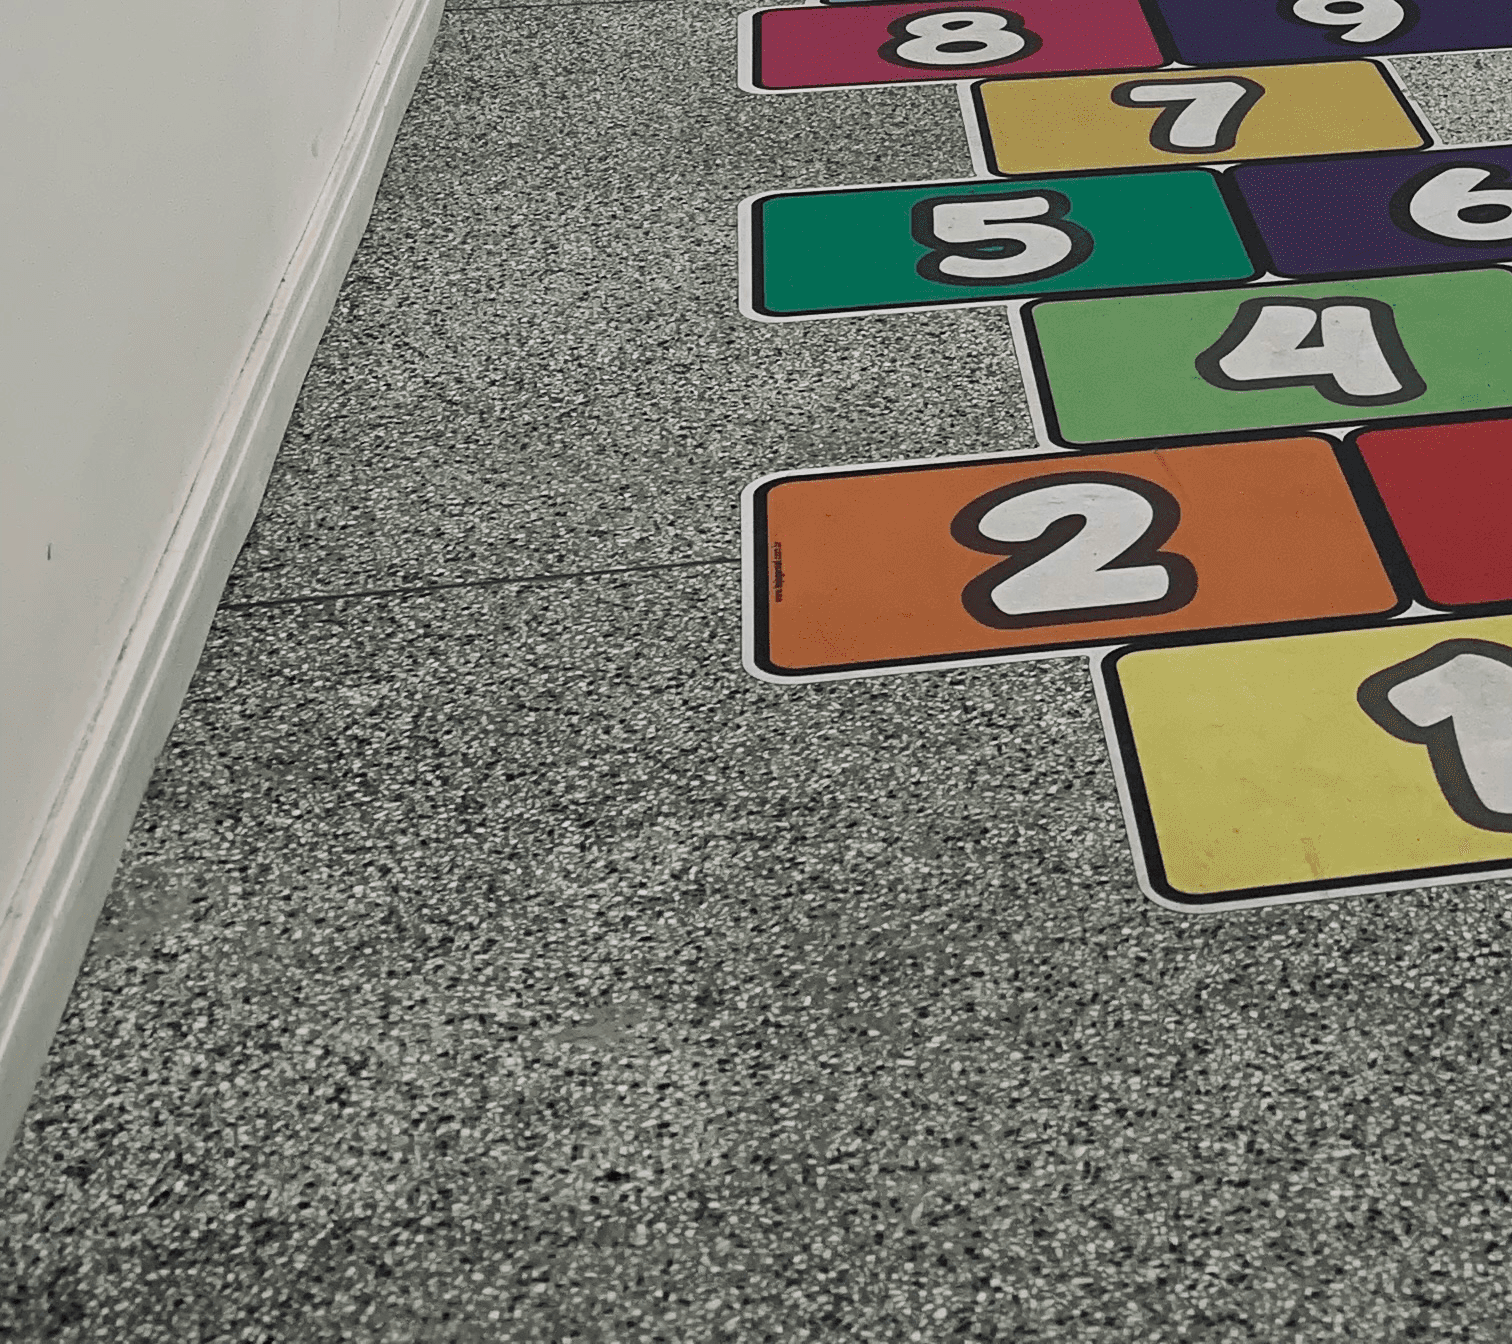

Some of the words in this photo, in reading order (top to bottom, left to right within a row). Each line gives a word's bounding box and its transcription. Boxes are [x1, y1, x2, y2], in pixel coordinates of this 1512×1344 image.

[892, 9, 1029, 67] 8
[1125, 79, 1251, 150] 7
[928, 194, 1076, 280] 5
[1215, 303, 1407, 398] 4
[974, 481, 1173, 617] 2
